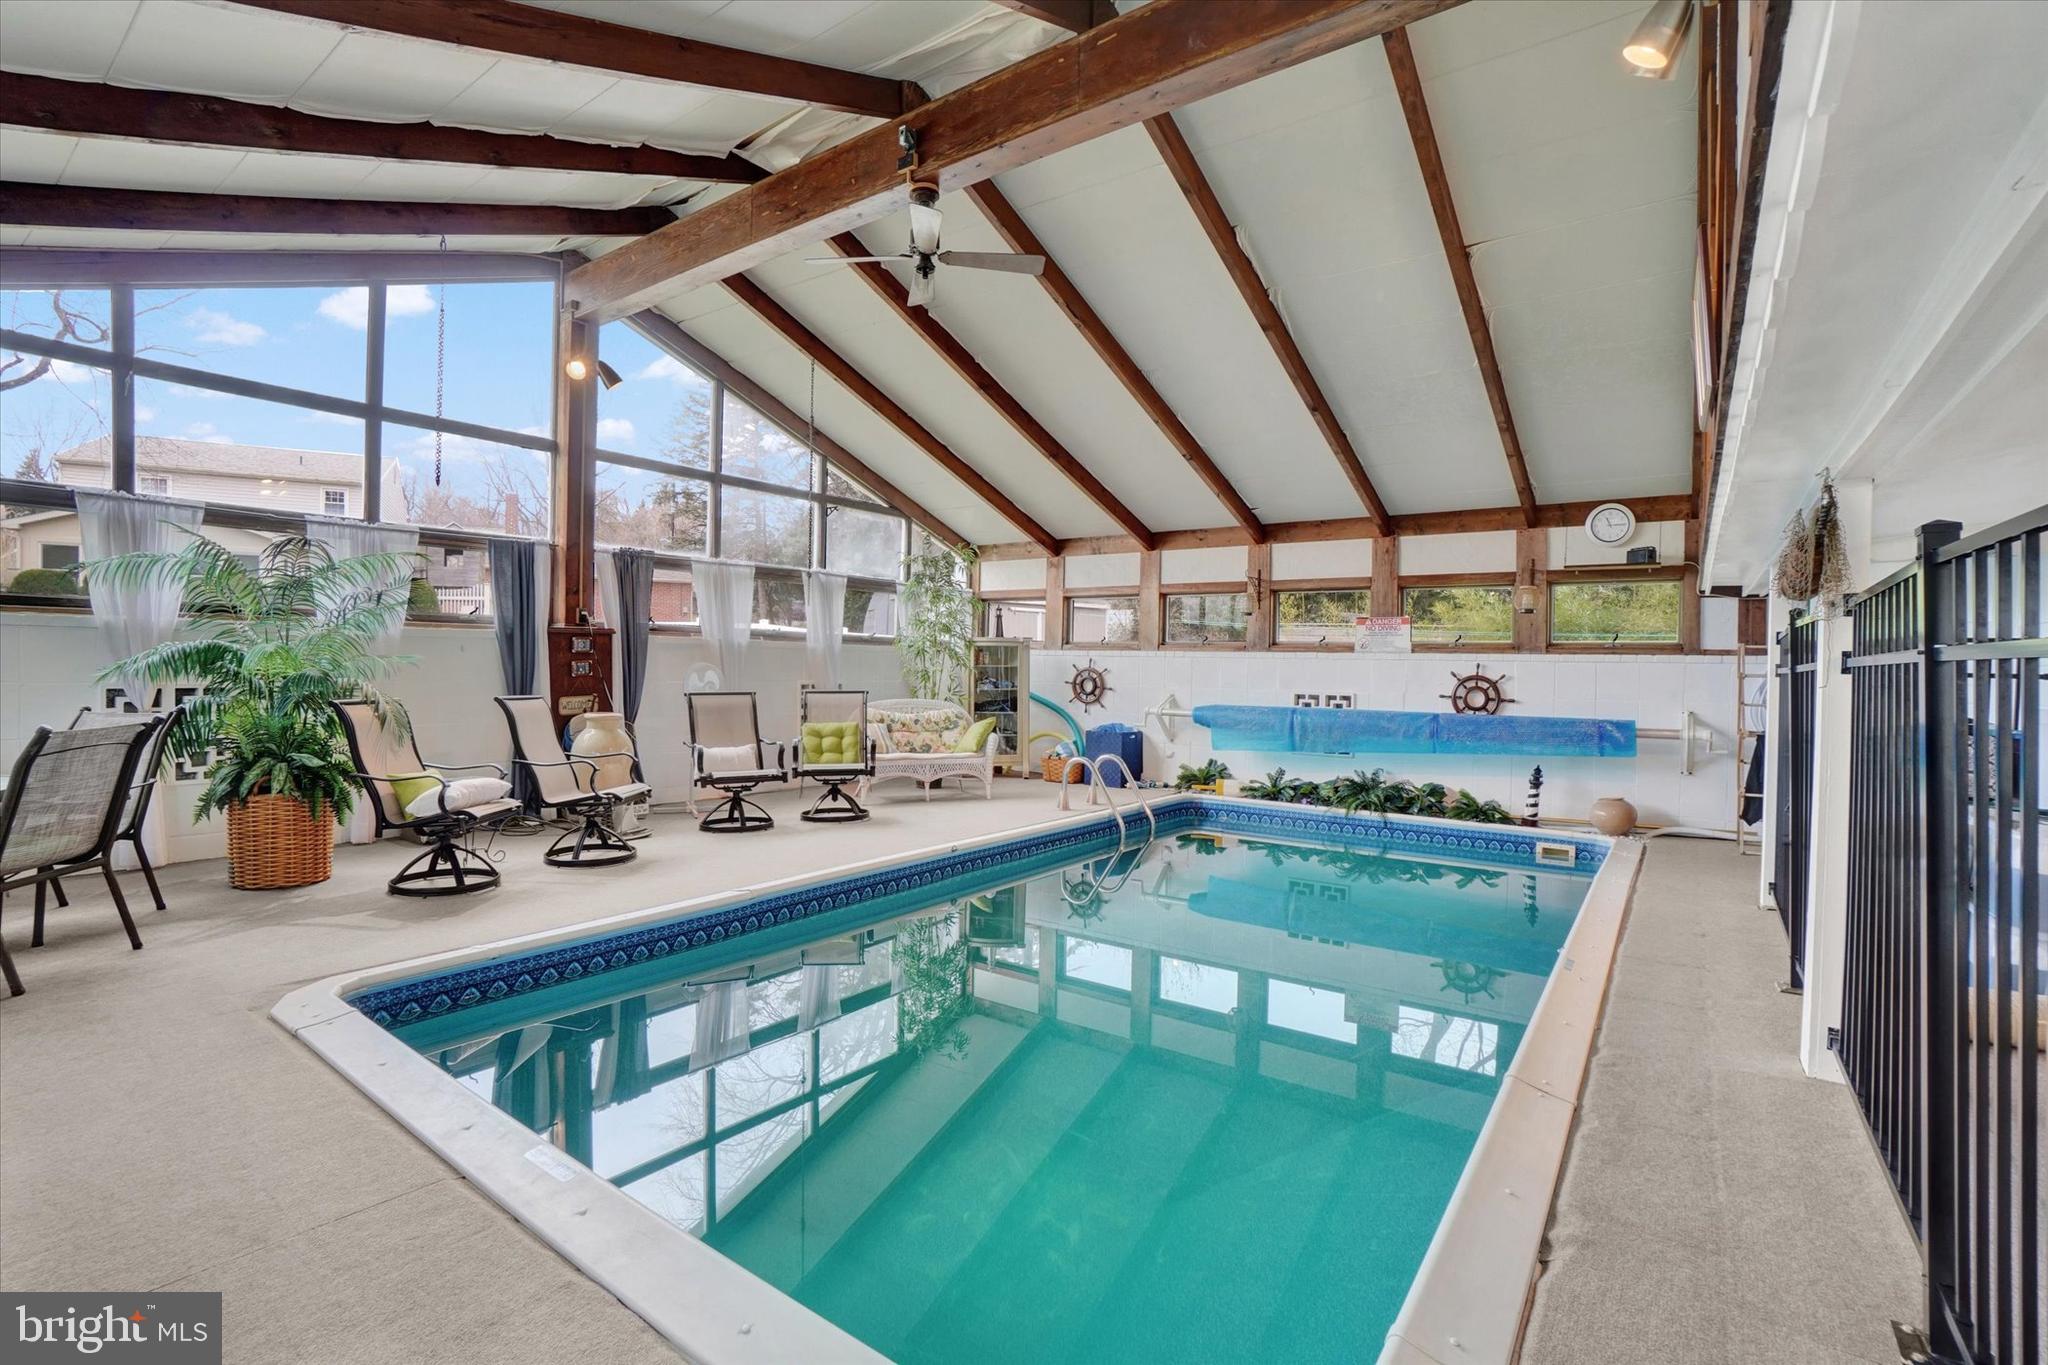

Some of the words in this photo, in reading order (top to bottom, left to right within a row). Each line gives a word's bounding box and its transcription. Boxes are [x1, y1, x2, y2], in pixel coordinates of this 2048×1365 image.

[1371, 617, 1401, 625] DANGER
[1365, 624, 1377, 632] NO
[1378, 624, 1402, 632] DIVING
